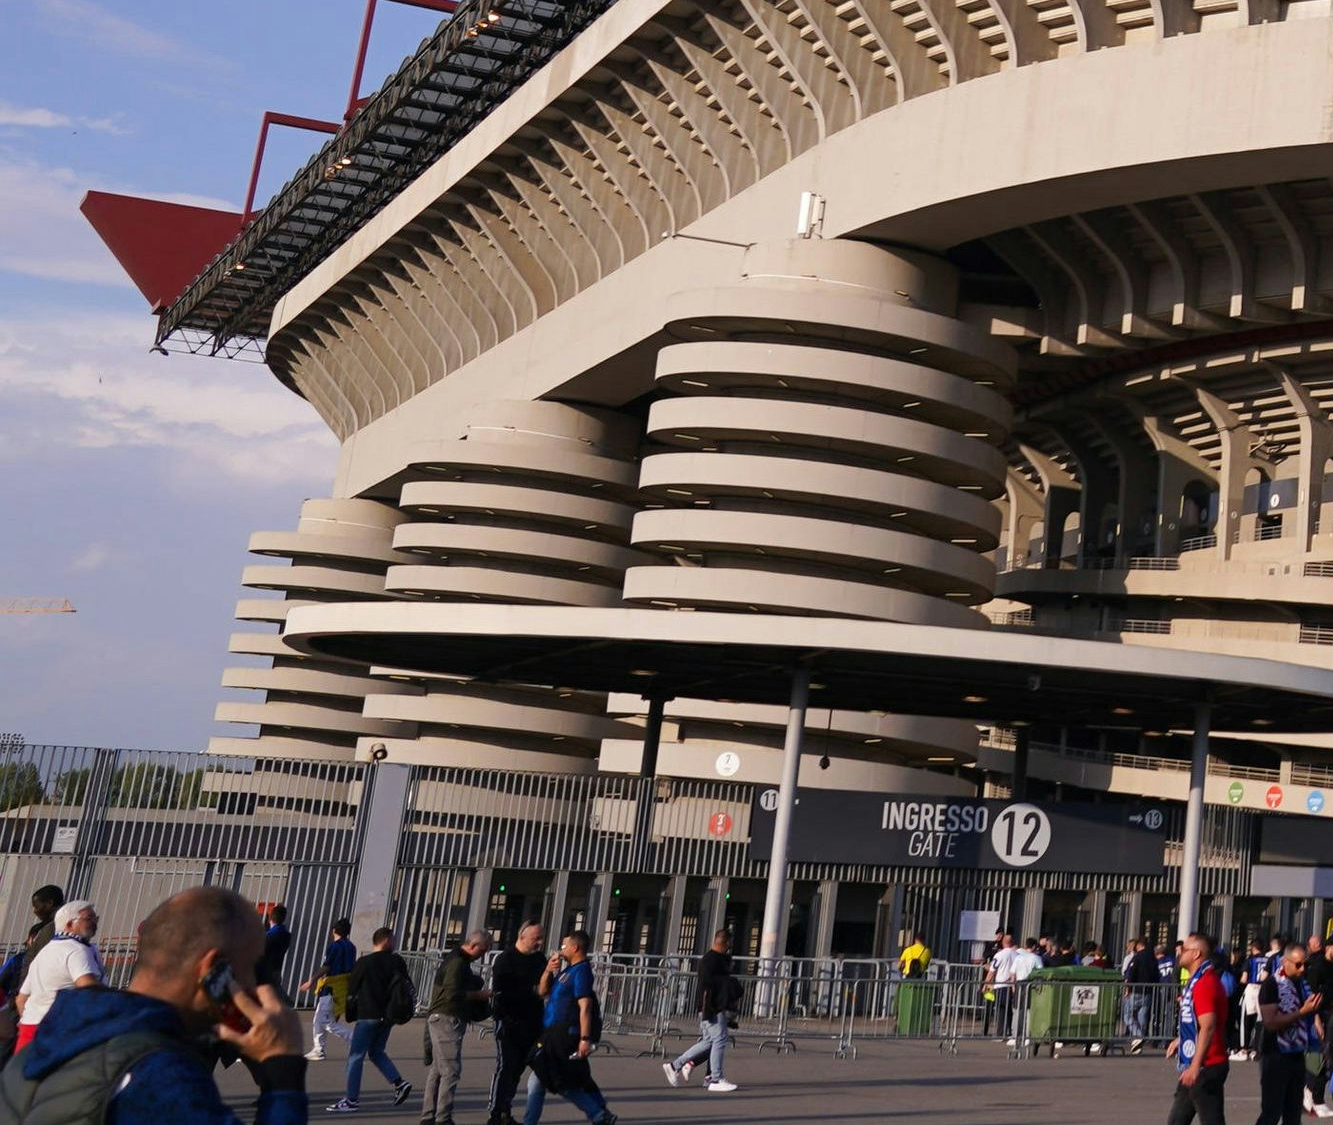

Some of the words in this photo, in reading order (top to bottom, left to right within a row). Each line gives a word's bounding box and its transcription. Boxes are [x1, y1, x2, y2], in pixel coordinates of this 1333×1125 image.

[763, 792, 777, 808] 11
[881, 801, 989, 833] INGRESSO
[908, 831, 960, 858] GATE
[1002, 810, 1042, 857] 12
